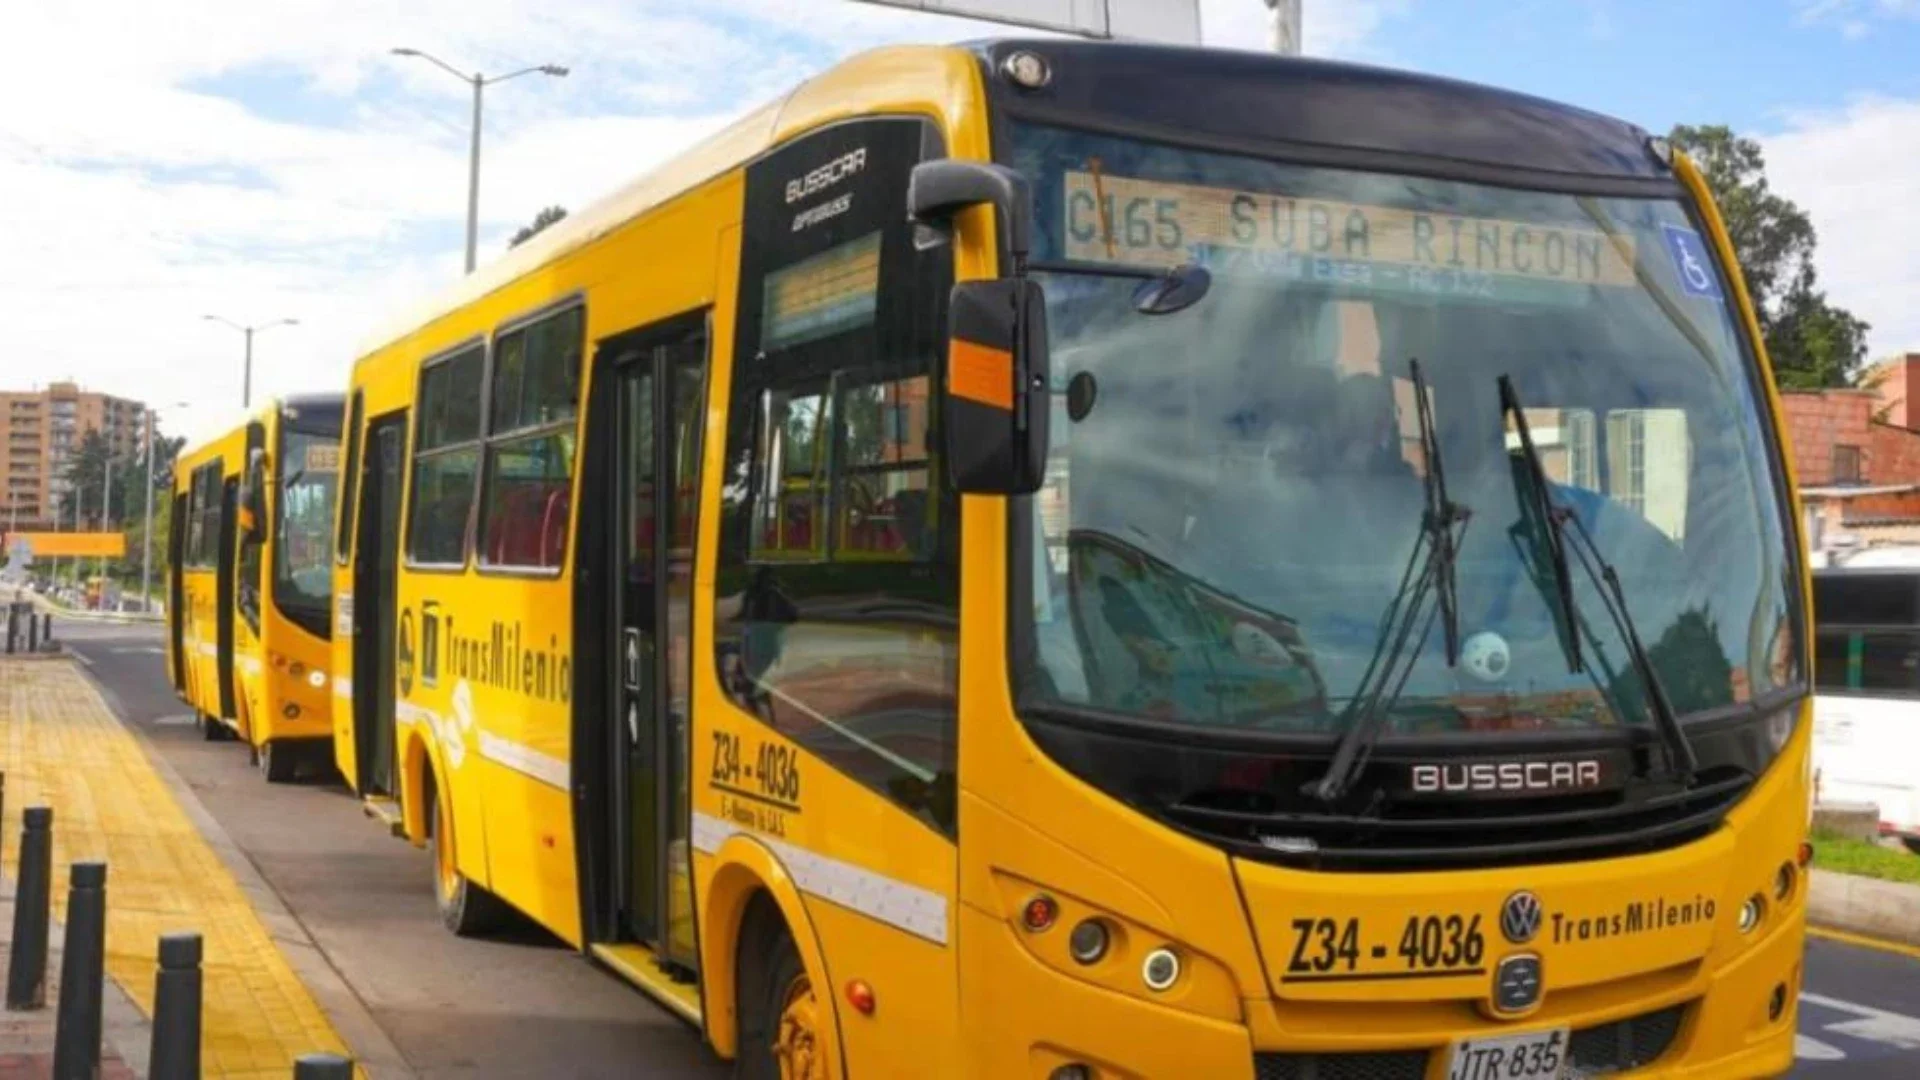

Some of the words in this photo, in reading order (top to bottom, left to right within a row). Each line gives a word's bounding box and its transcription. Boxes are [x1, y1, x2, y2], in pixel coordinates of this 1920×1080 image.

[785, 147, 866, 203] BUSSCAR
[1069, 189, 1182, 250] C165
[1230, 193, 1371, 257] SUBA
[1411, 213, 1601, 279] RINCON
[445, 614, 570, 703] TransMilenio
[713, 730, 740, 783] Z34
[756, 741, 799, 802] 4036
[1411, 760, 1600, 792] BUSSCAR
[1288, 917, 1360, 972] Z34
[1397, 913, 1485, 969] 4036
[1551, 893, 1716, 944] TransMilenio
